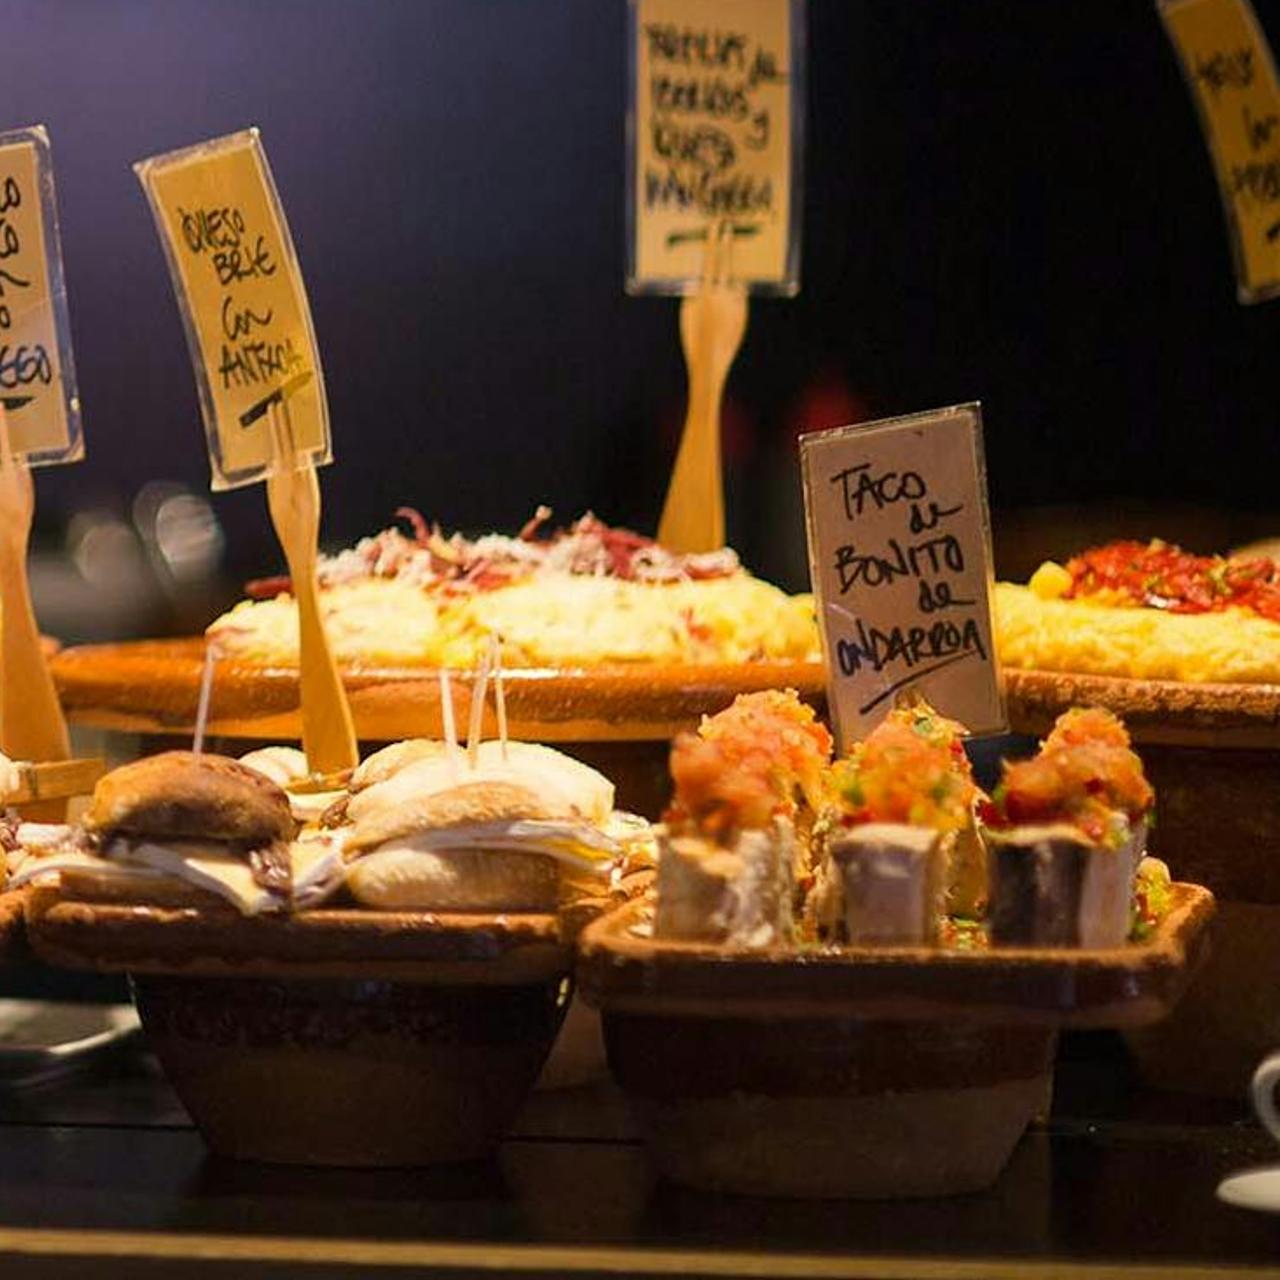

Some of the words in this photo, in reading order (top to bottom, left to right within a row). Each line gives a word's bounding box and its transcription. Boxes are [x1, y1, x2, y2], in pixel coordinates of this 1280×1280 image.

[213, 235, 277, 286] BRIE
[830, 462, 928, 521] TACO
[909, 501, 964, 535] de
[834, 534, 965, 595] BONITO
[918, 581, 976, 614] de
